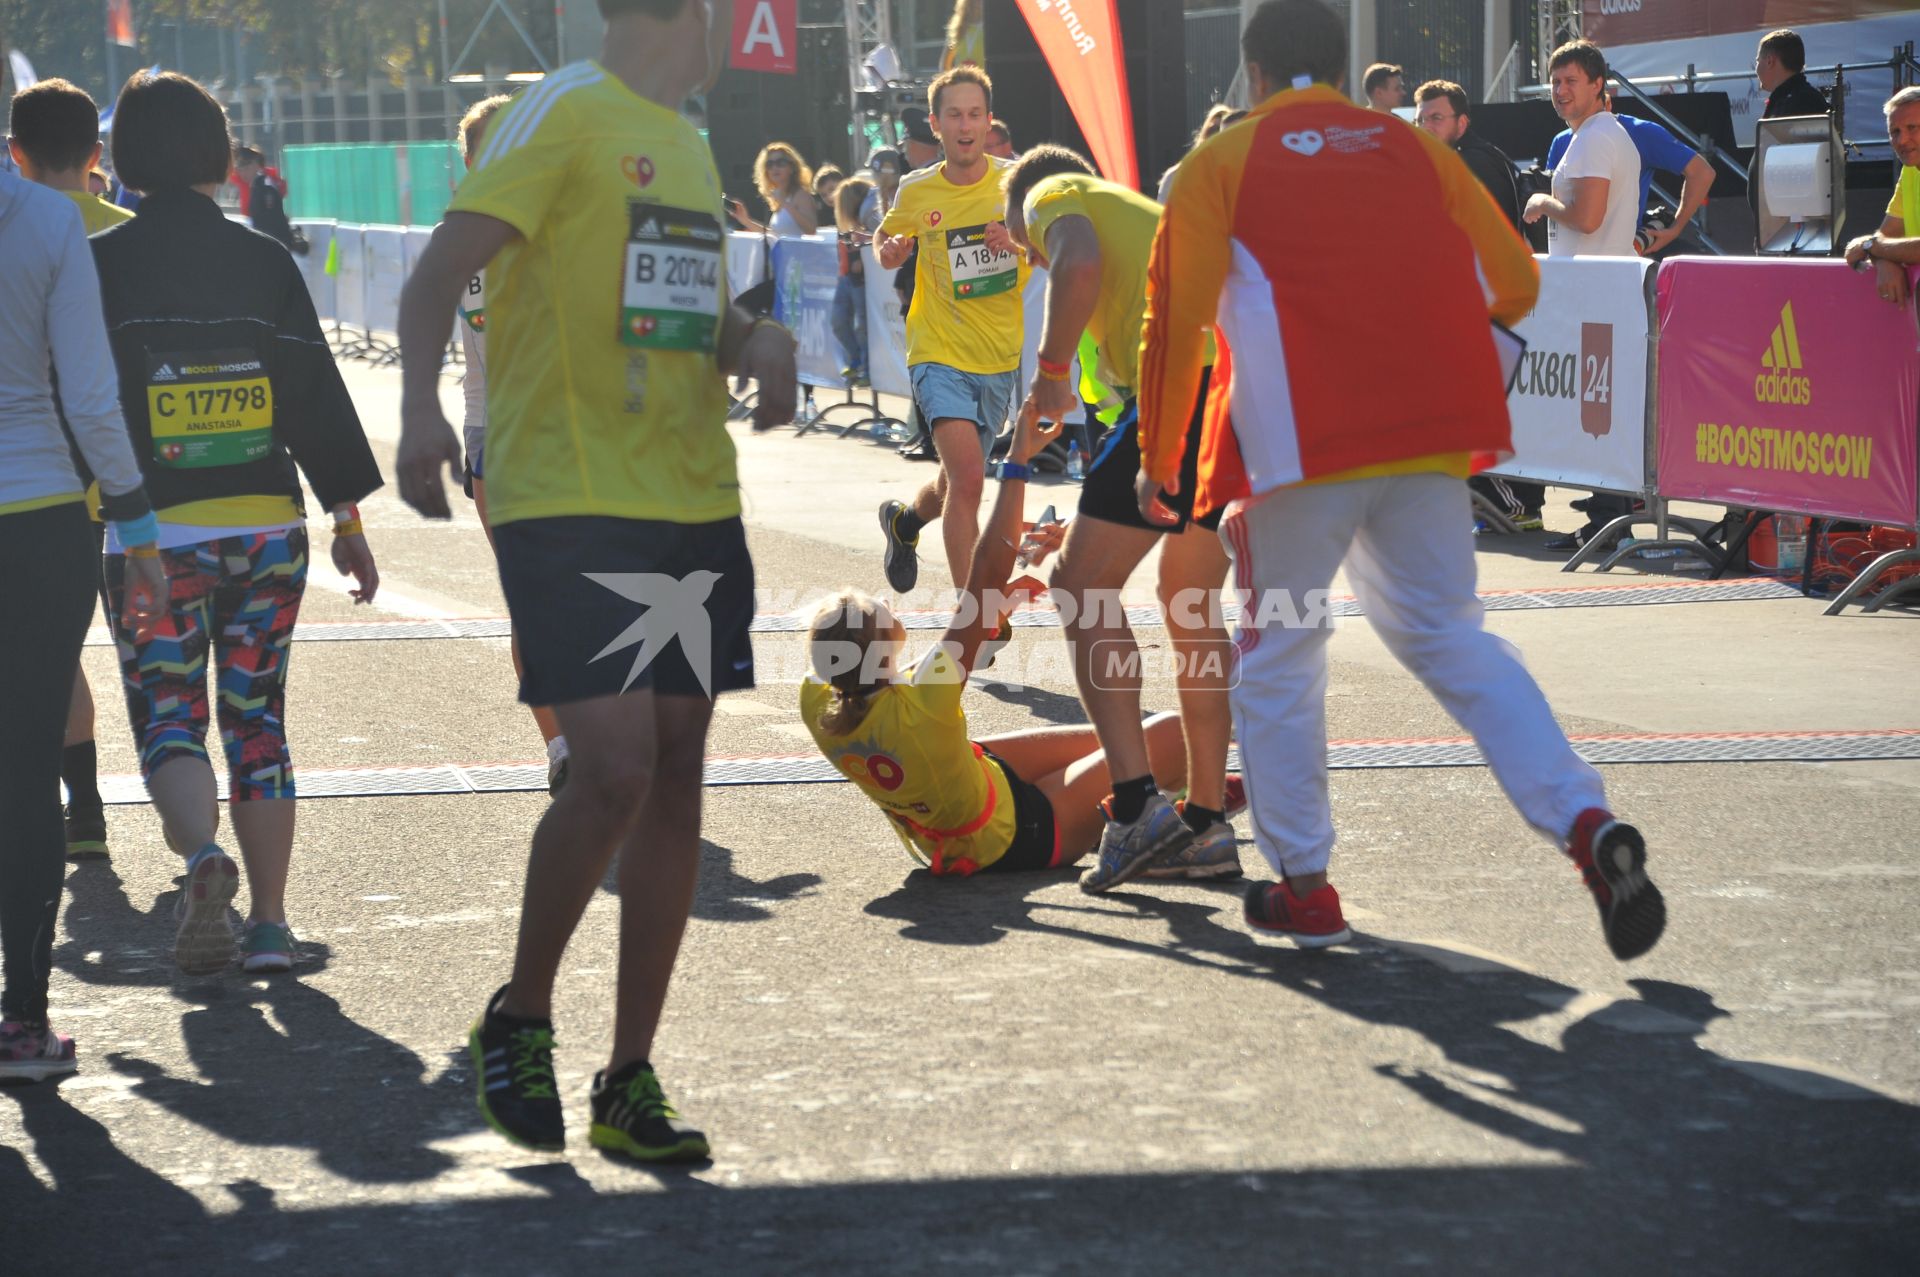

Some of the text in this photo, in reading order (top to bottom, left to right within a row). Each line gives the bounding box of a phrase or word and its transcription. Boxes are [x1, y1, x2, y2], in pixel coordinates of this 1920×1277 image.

[742, 1, 784, 57] A
[635, 253, 656, 284] B
[955, 253, 967, 268] A
[468, 276, 481, 296] B
[1516, 350, 1609, 403] сква 24
[1755, 367, 1811, 405] adidas
[156, 386, 266, 418] C 17798
[186, 420, 242, 431] ANASTASIA
[1696, 423, 1873, 479] #BOOSTMOSCOW
